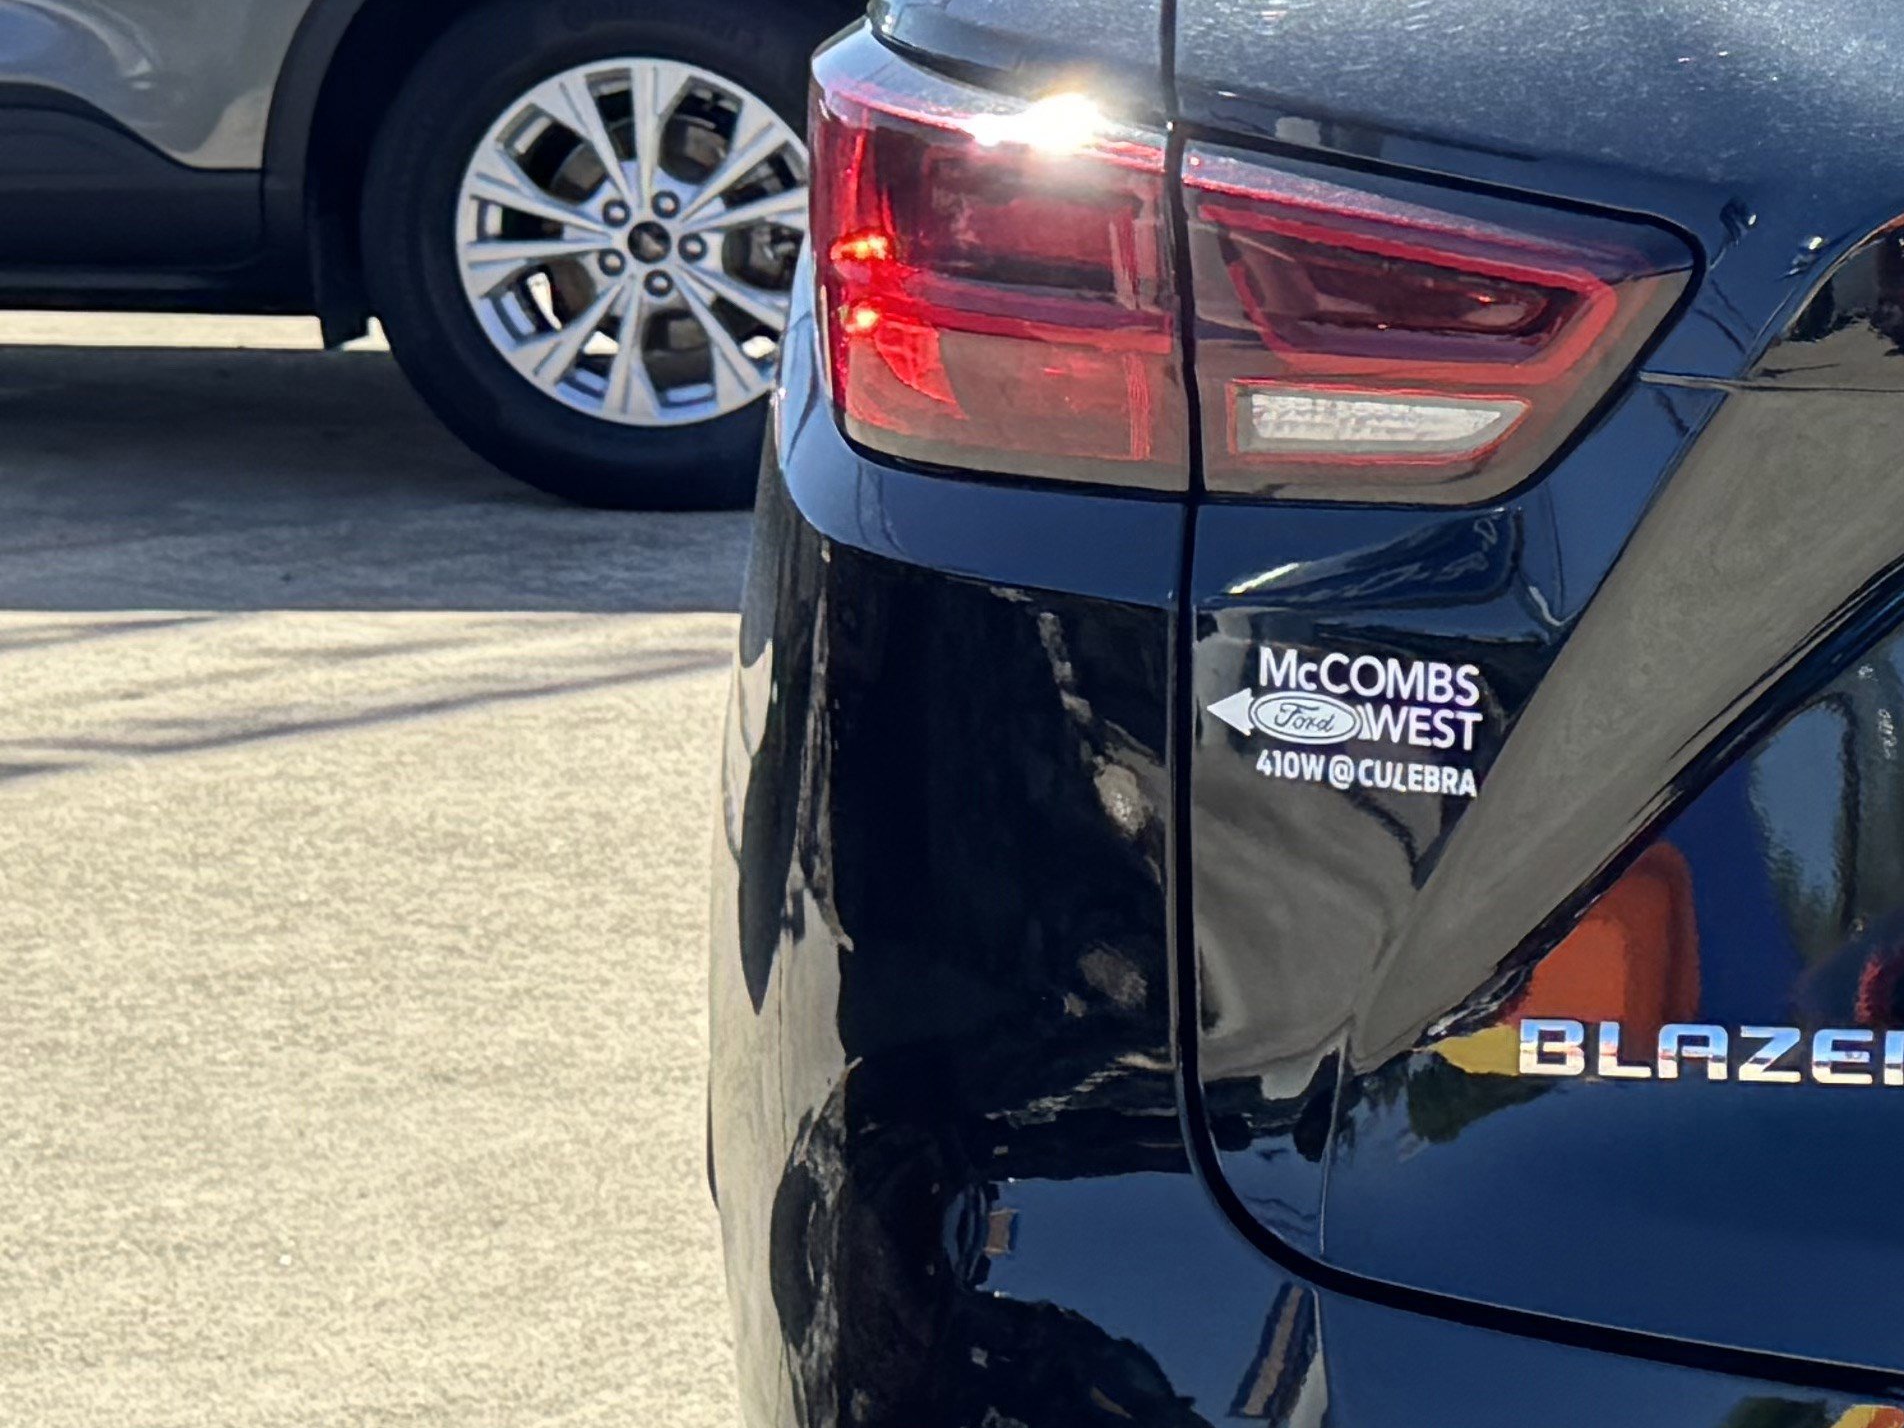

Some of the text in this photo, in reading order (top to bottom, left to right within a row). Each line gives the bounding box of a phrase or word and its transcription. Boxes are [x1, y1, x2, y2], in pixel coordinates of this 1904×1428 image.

[1259, 646, 1480, 707] McCOMBS
[1274, 702, 1483, 751] Ford WEST
[1358, 758, 1477, 798] CULEBRA
